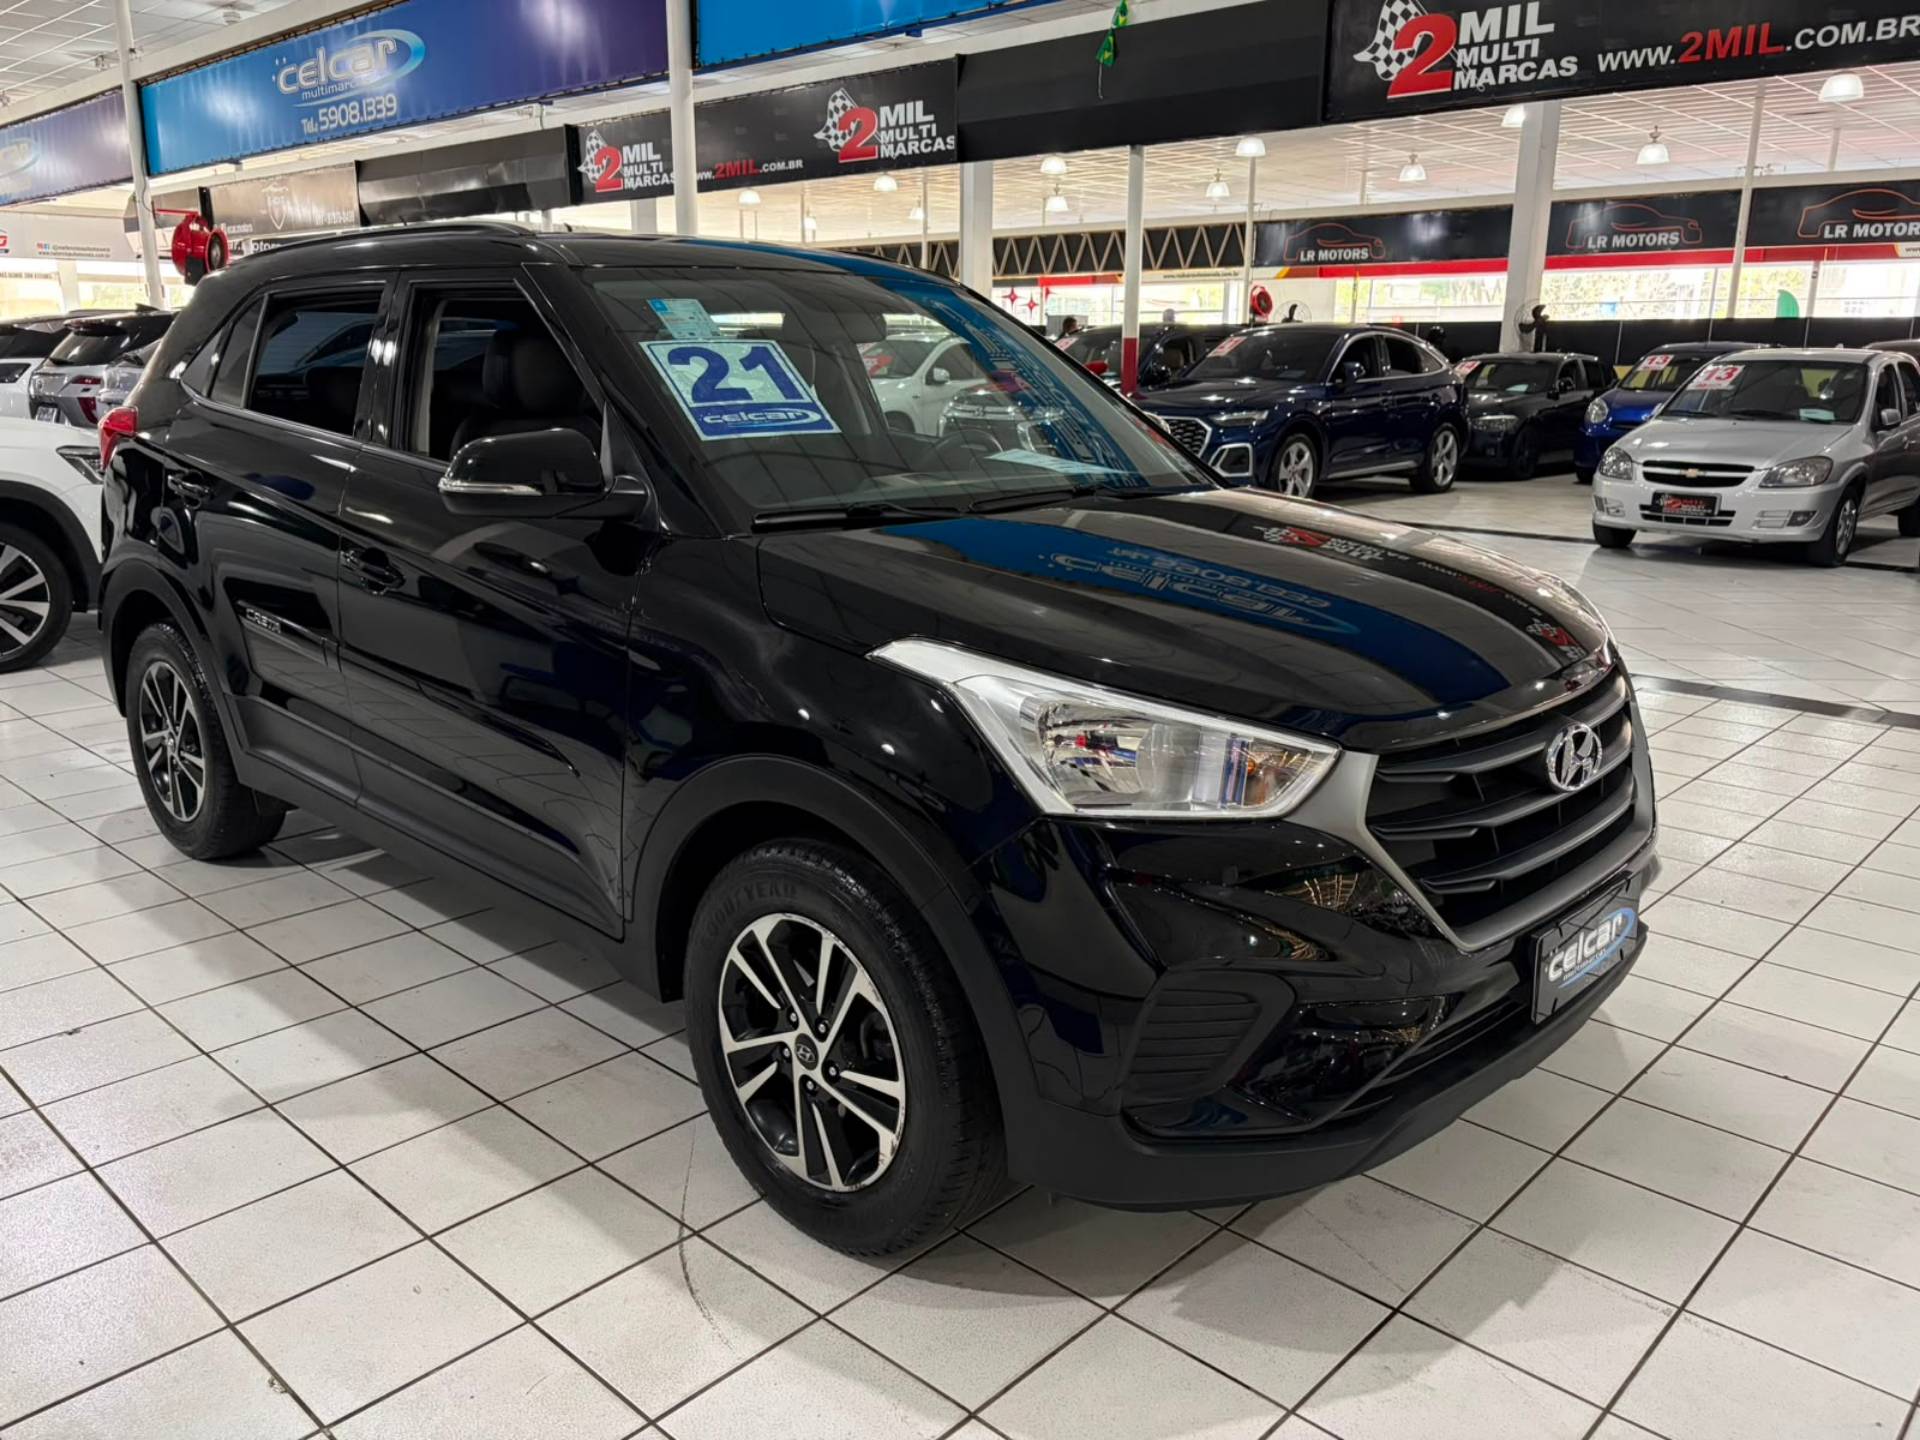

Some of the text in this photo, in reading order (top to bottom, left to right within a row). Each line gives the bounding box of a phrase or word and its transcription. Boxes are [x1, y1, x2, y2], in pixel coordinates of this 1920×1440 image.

[1387, 1, 1555, 100] 2 MIL
[1456, 38, 1540, 68] MULTI
[277, 38, 397, 94] celcar
[1453, 56, 1578, 91] MARCAS
[318, 93, 397, 131] 5908.1339
[838, 100, 935, 164] 2 MIL
[880, 123, 937, 145] MULTI
[880, 135, 956, 160] MARCAS
[595, 142, 661, 193] 2 MIL
[624, 161, 663, 178] MULTI
[1587, 232, 1680, 249] LR MOTORS
[1823, 224, 1848, 239] LR
[1300, 248, 1369, 262] LR MOTORS
[667, 346, 805, 402] 21
[1704, 366, 1739, 382] 13
[703, 411, 803, 425] celcar
[245, 607, 282, 634] CRETA
[1548, 912, 1623, 982] celcar
